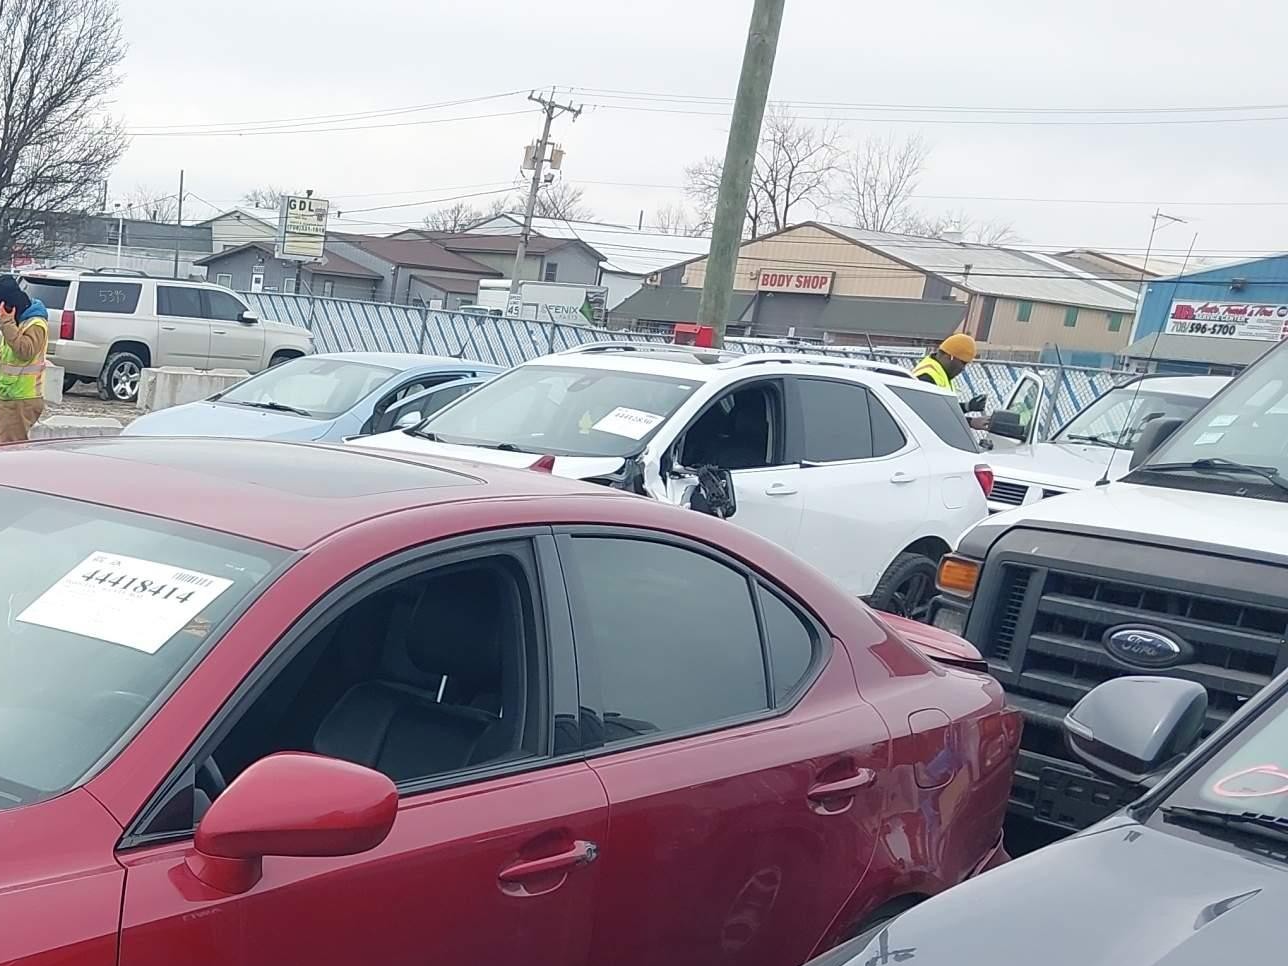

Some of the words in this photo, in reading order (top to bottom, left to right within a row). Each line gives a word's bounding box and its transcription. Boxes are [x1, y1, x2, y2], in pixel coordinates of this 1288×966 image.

[289, 199, 314, 212] GDL
[761, 273, 793, 287] BODY
[795, 275, 829, 289] SHOP
[507, 306, 519, 316] 45
[549, 304, 579, 314] FENIX
[81, 569, 196, 604] 44418414
[1121, 634, 1162, 656] Ford
